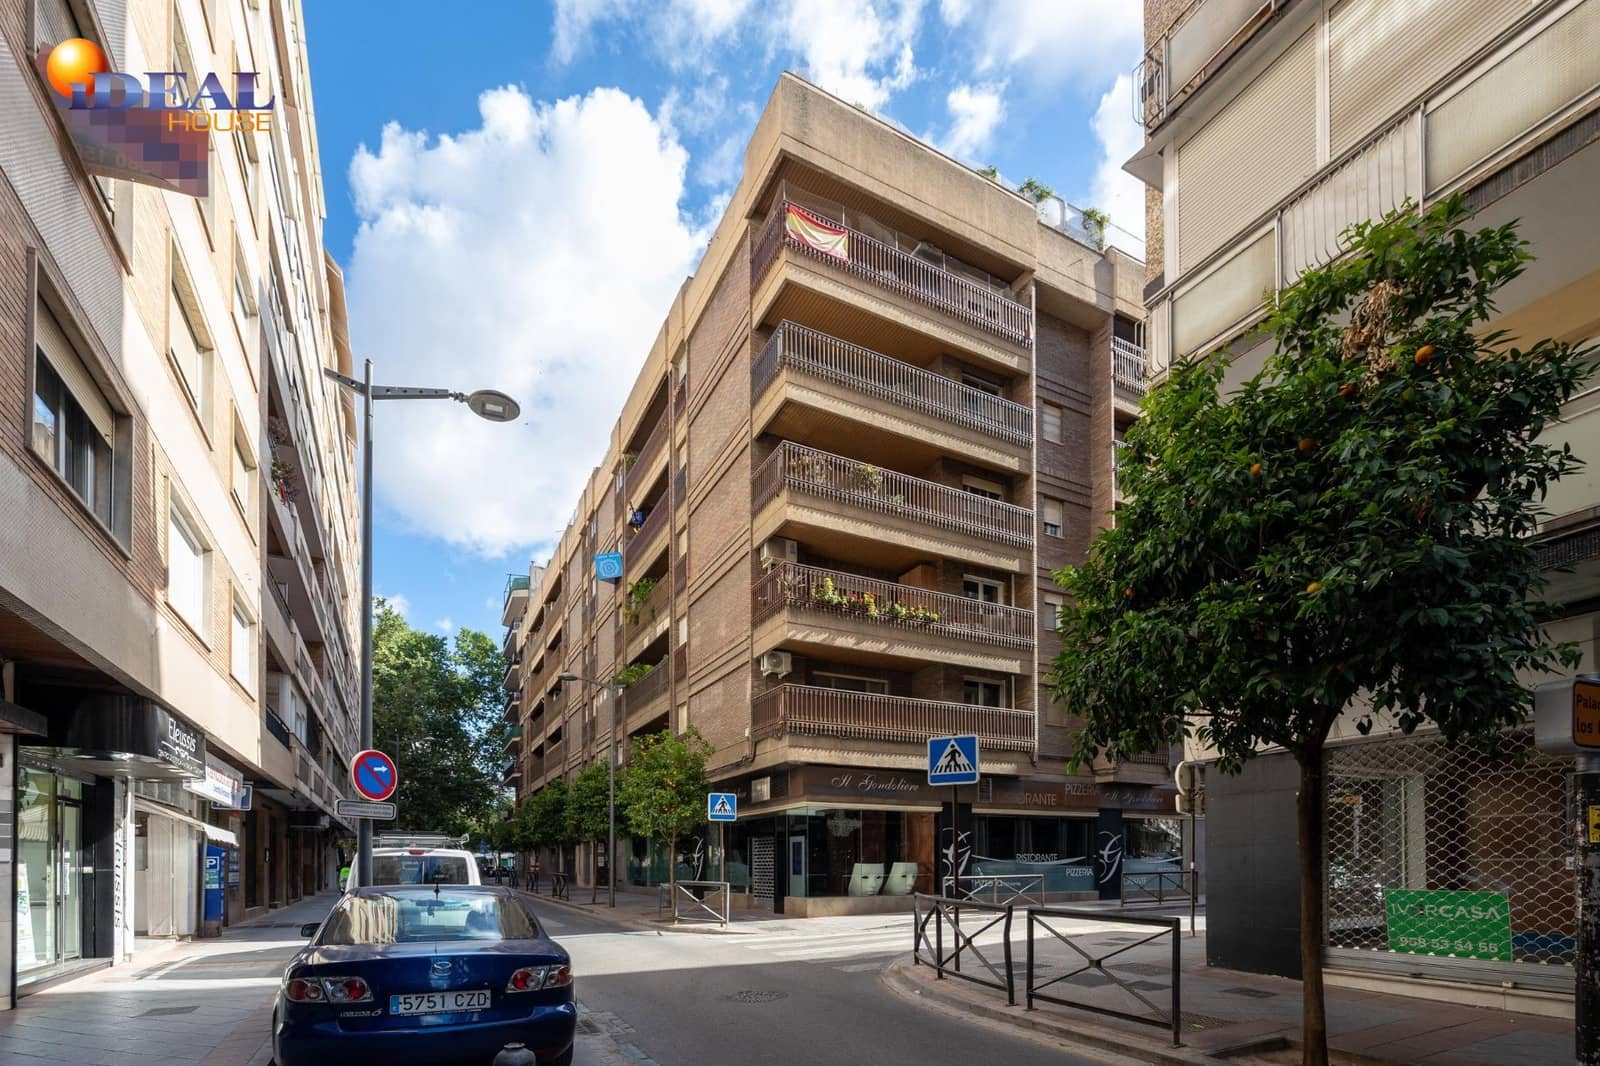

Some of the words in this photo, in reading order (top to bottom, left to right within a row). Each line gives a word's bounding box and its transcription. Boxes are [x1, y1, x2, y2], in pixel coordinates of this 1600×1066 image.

[168, 717, 196, 752] Eleussis
[1577, 717, 1593, 734] los
[858, 773, 919, 792] Gondoliere
[1016, 853, 1058, 864] RISTORANTE
[1066, 868, 1094, 877] PIZZERIA
[403, 995, 445, 1011] 5751
[455, 992, 487, 1008] CZD
